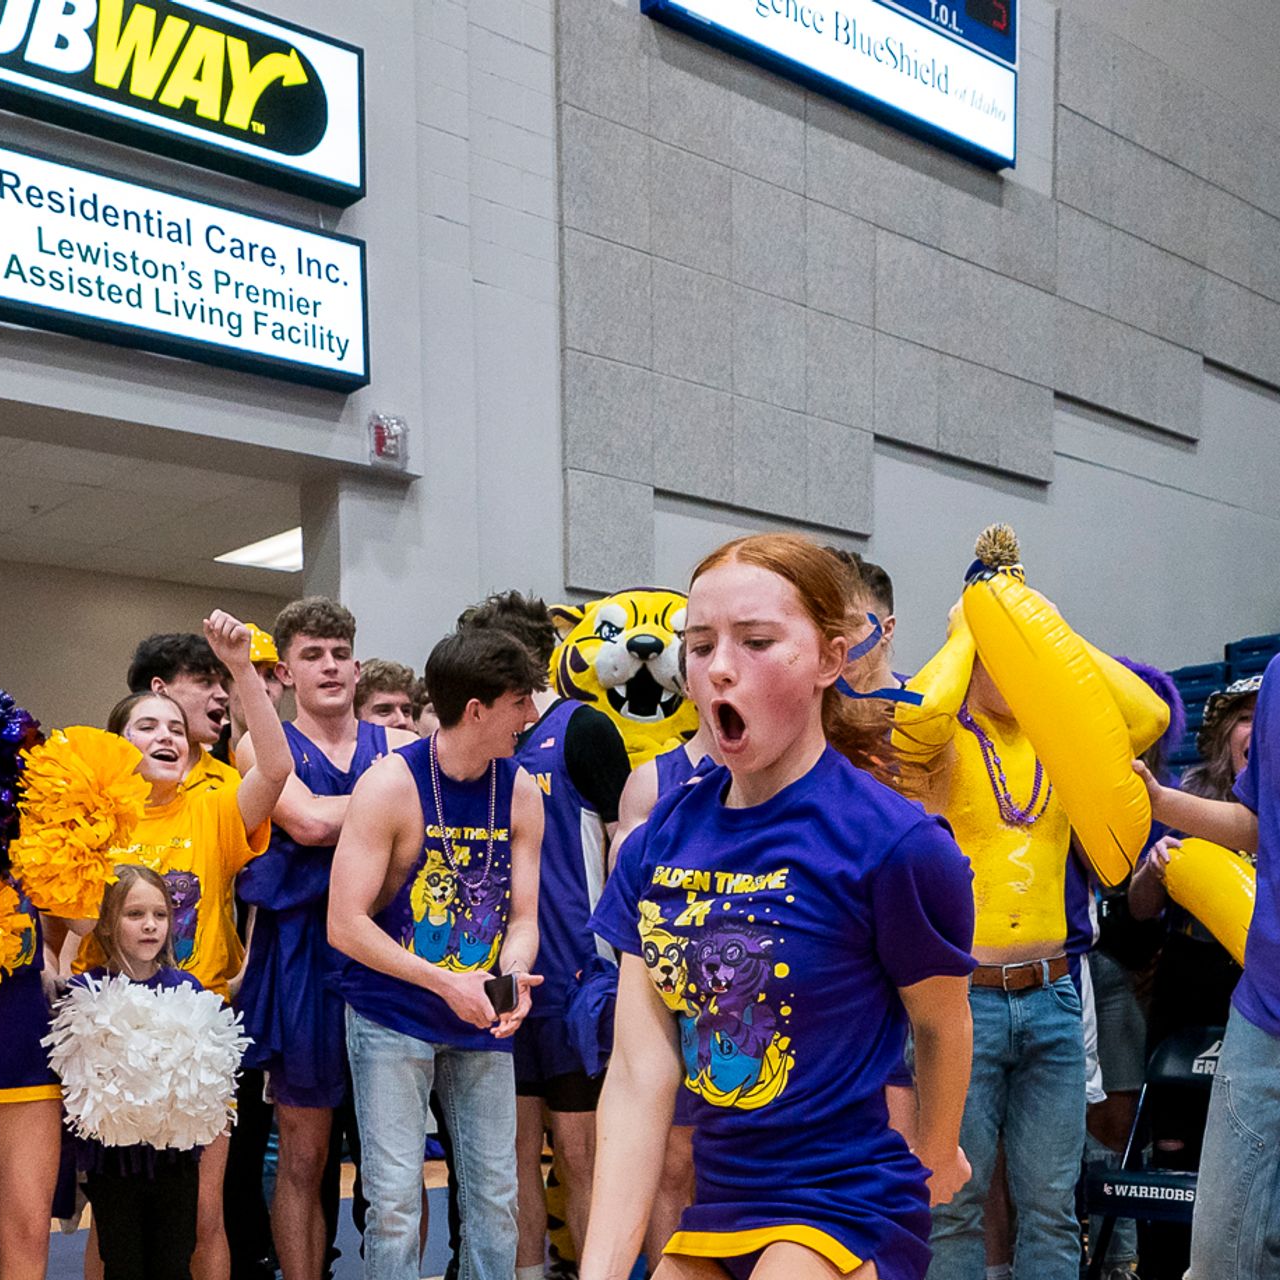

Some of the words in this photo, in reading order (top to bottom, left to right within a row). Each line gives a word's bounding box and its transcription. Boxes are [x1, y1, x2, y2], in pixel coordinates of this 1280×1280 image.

[835, 11, 949, 95] BlueShield
[970, 89, 1007, 122] Idaho
[37, 226, 203, 290] Lewiston's
[214, 269, 322, 318] Premier
[205, 224, 286, 275] Care,
[297, 247, 349, 287] Inc.
[4, 254, 143, 309] Assisted
[155, 287, 243, 338] Living
[254, 310, 350, 361] Facility
[1114, 1184, 1196, 1203] WARRIORS
